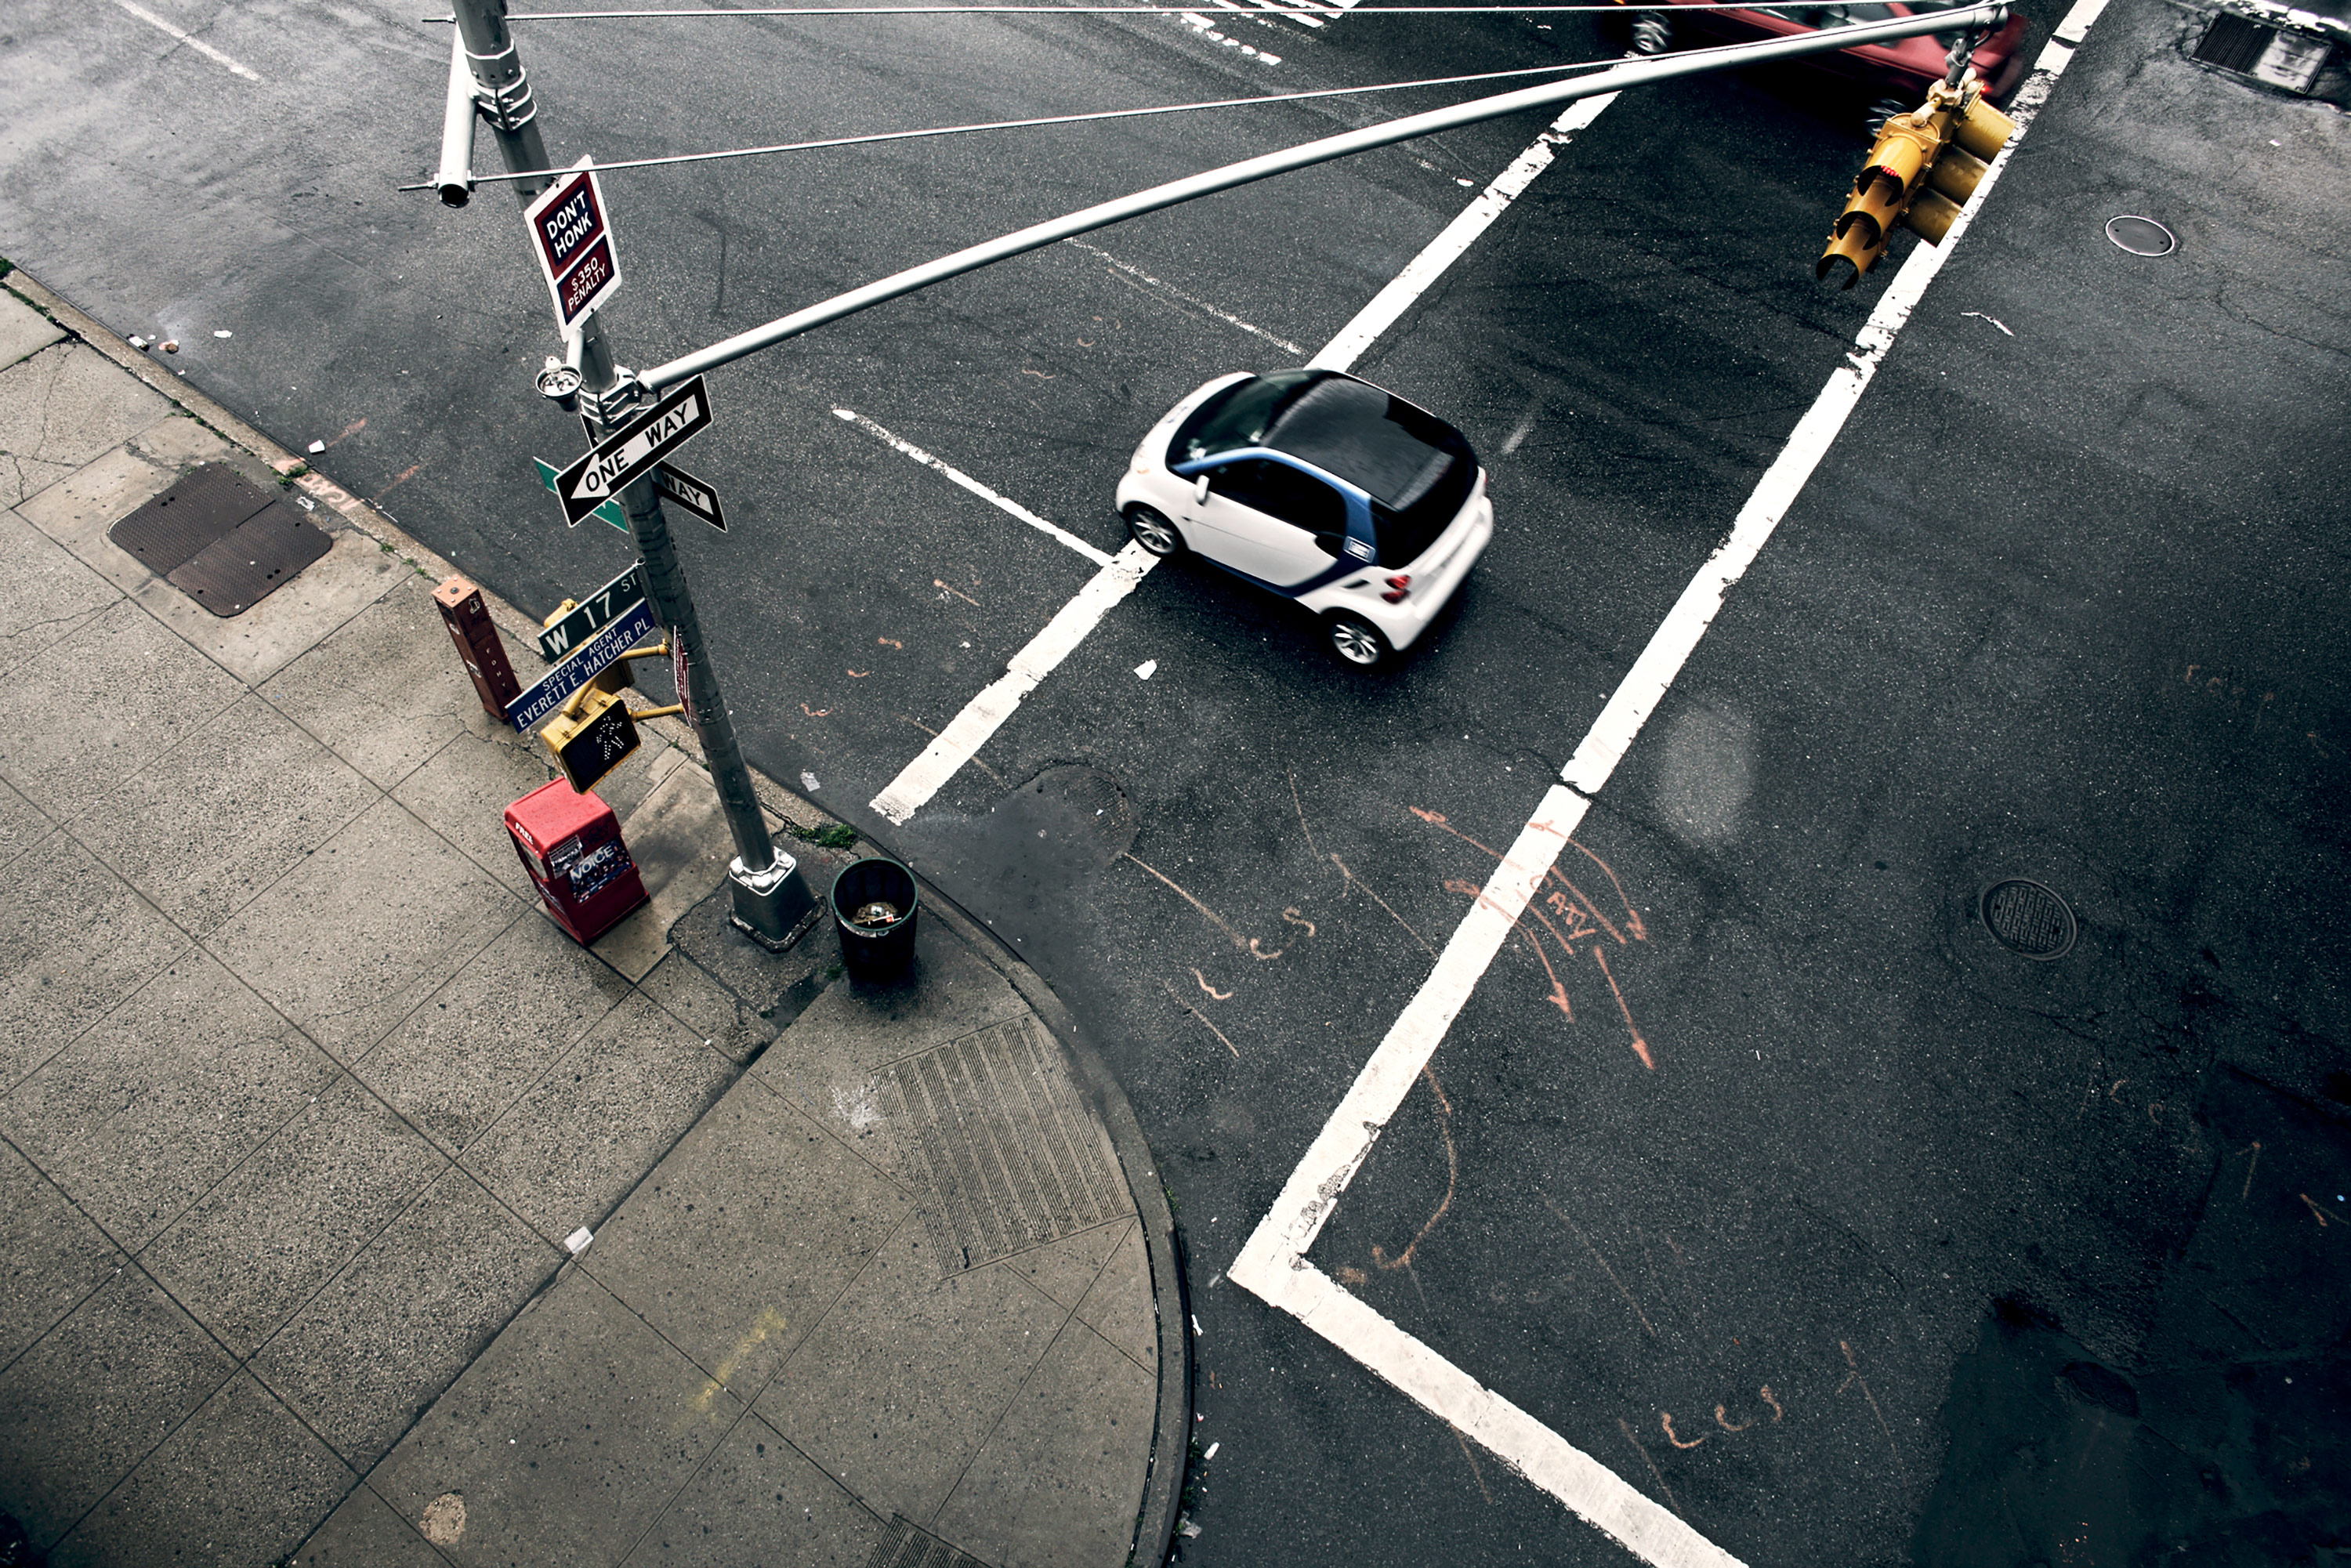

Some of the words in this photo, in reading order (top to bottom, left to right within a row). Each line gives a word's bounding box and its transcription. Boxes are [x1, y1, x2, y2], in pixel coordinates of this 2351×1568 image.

[546, 190, 588, 241] DON'T
[554, 212, 593, 259] HONK
[567, 263, 607, 313] PENALTY
[571, 256, 599, 292] $350
[585, 447, 630, 493] ONE
[645, 403, 688, 447] WAY
[661, 473, 701, 506] WAY
[545, 625, 570, 656] W
[584, 590, 612, 630] 17
[621, 572, 638, 592] ST
[516, 682, 568, 729] EVERETT
[571, 670, 584, 688] E.
[585, 630, 634, 676] HATCHER
[634, 617, 651, 638] PL
[542, 657, 585, 692] SPECIAL
[589, 627, 618, 657] AGENT
[570, 845, 615, 883] VOICE
